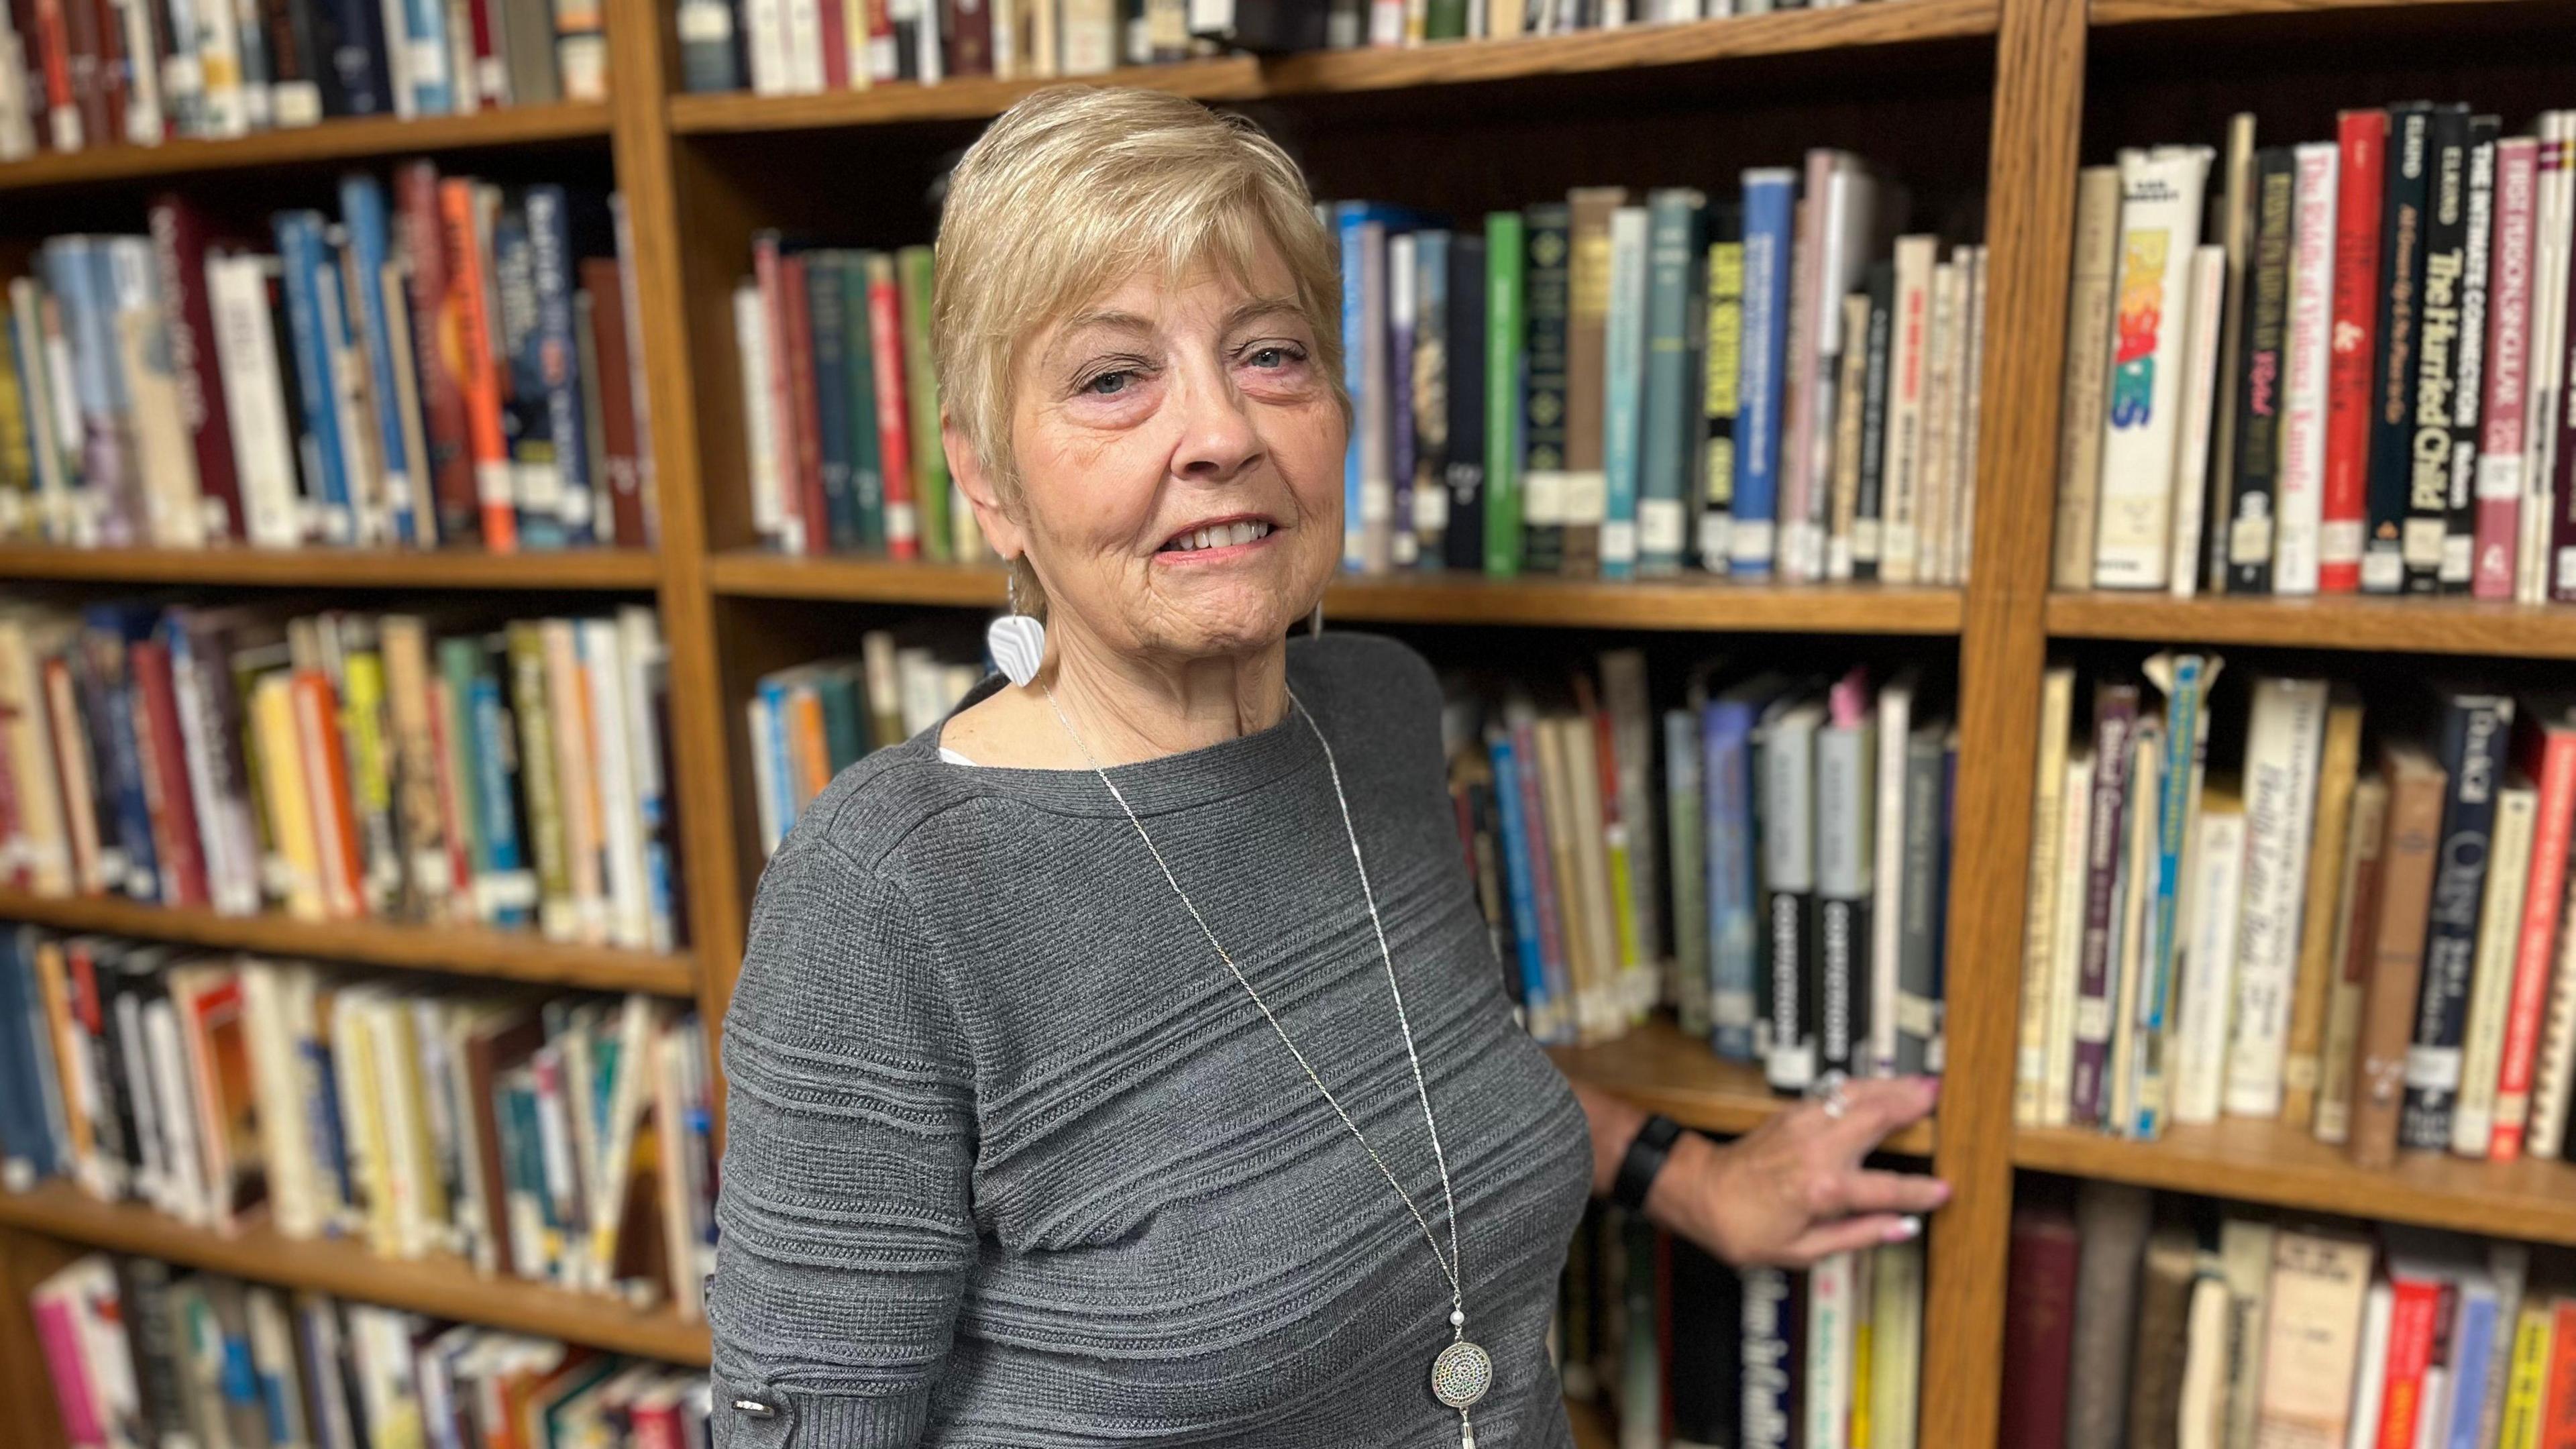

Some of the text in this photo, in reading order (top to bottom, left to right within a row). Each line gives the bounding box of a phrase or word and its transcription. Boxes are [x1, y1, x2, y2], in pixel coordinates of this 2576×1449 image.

[2401, 113, 2425, 179] ELKIND
[2302, 155, 2328, 195] The
[2436, 144, 2463, 226] ELKIND
[2503, 158, 2531, 213] FIRST
[2297, 201, 2326, 270] Riddle
[2398, 203, 2419, 227] All
[2394, 227, 2417, 278] Grown
[2296, 275, 2321, 298] of
[2390, 278, 2413, 301] Up
[2290, 297, 2320, 391] Violence
[2333, 319, 2365, 354] &
[2389, 317, 2410, 340] No
[2449, 140, 2494, 509] THE INTIMATE CONNECTION Nelson
[2386, 340, 2408, 382] Place
[2408, 246, 2463, 511] The Hurried Child
[2493, 299, 2526, 409] SINGULAR
[2383, 396, 2405, 425] Go
